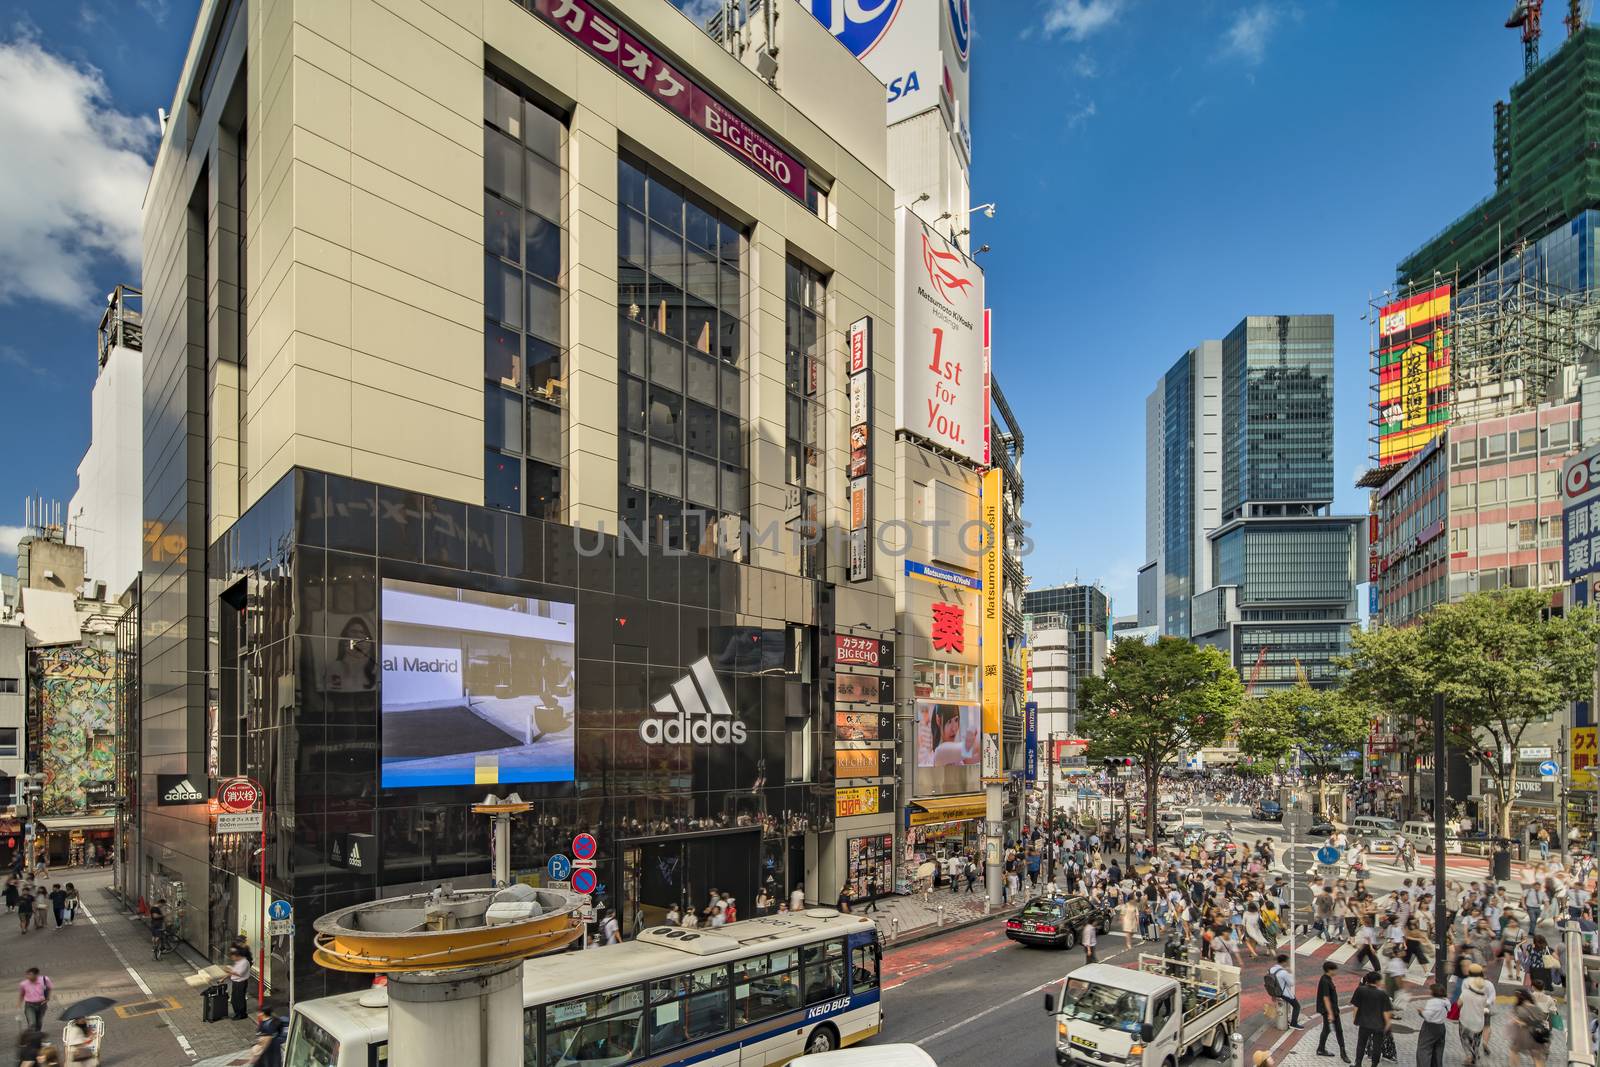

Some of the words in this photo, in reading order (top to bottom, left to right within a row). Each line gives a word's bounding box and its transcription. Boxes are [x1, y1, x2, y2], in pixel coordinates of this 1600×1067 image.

[551, 0, 685, 98] カラオケ
[705, 105, 740, 145] BIG
[744, 135, 791, 184] ECHO
[917, 286, 953, 316] Matsumoto
[928, 326, 962, 387] 1st
[935, 381, 957, 406] for
[924, 567, 953, 582] Matsumoto
[986, 551, 996, 619] Matsumoto
[931, 602, 965, 654] 薬
[837, 647, 854, 660] BIG
[855, 650, 878, 663] ECHO
[843, 637, 873, 650] カラオケ
[404, 656, 458, 674] Madrid
[639, 713, 747, 745] adidas
[164, 791, 202, 801] adidas
[227, 790, 254, 802] 消火栓
[1515, 781, 1541, 792] STORE
[552, 861, 562, 877] P
[808, 1003, 831, 1019] KEIO
[831, 996, 851, 1011] BUS
